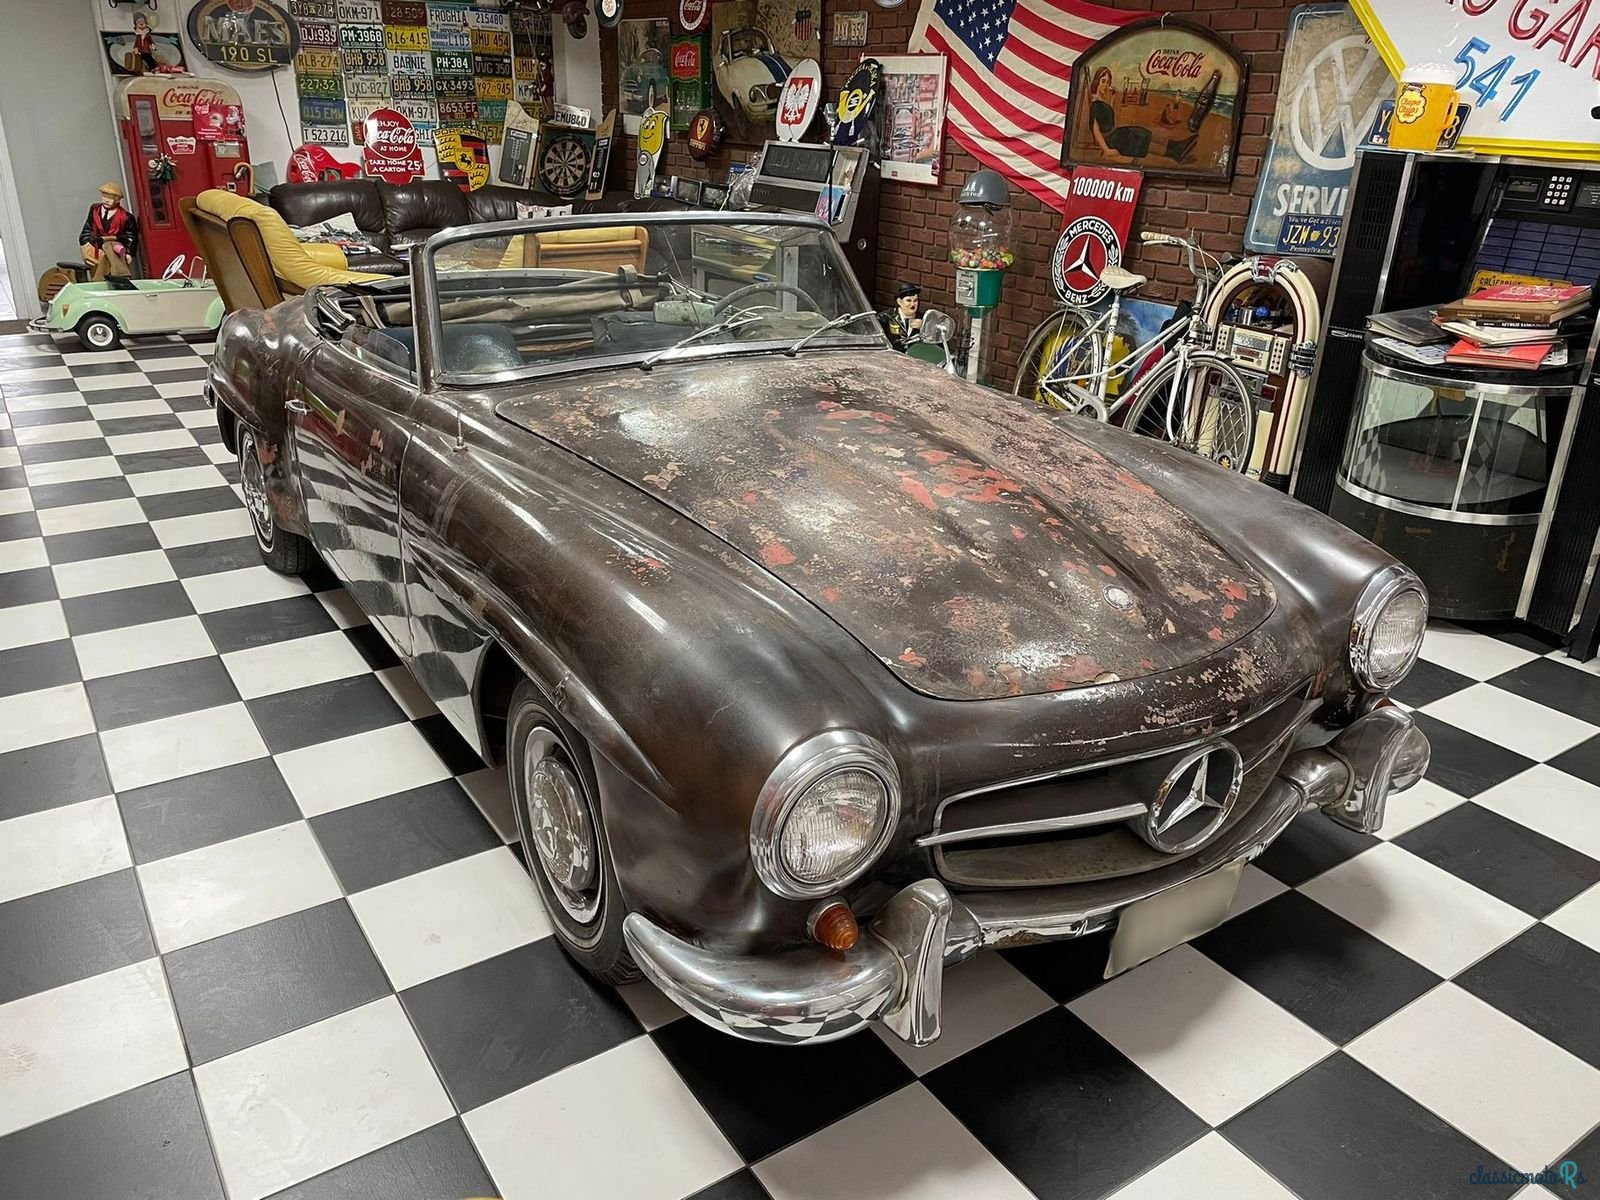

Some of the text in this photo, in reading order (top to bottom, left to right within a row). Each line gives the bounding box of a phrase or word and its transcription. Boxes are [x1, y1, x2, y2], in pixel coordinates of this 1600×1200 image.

[475, 13, 504, 25] 215480
[204, 15, 287, 45] MAES
[220, 46, 278, 63] 190 SL
[393, 55, 426, 70] BARNIE
[675, 50, 696, 67] Coca-Cola
[1146, 50, 1206, 79] Coca-Cola
[1454, 36, 1542, 122] 541
[163, 88, 225, 108] Coca-Cola
[312, 129, 328, 141] 523
[331, 130, 346, 142] 216
[1072, 176, 1135, 203] 100000 km
[1069, 220, 1114, 244] MERCEDES
[1289, 244, 1331, 254] Pennsylvania
[1065, 291, 1089, 304] BENZ
